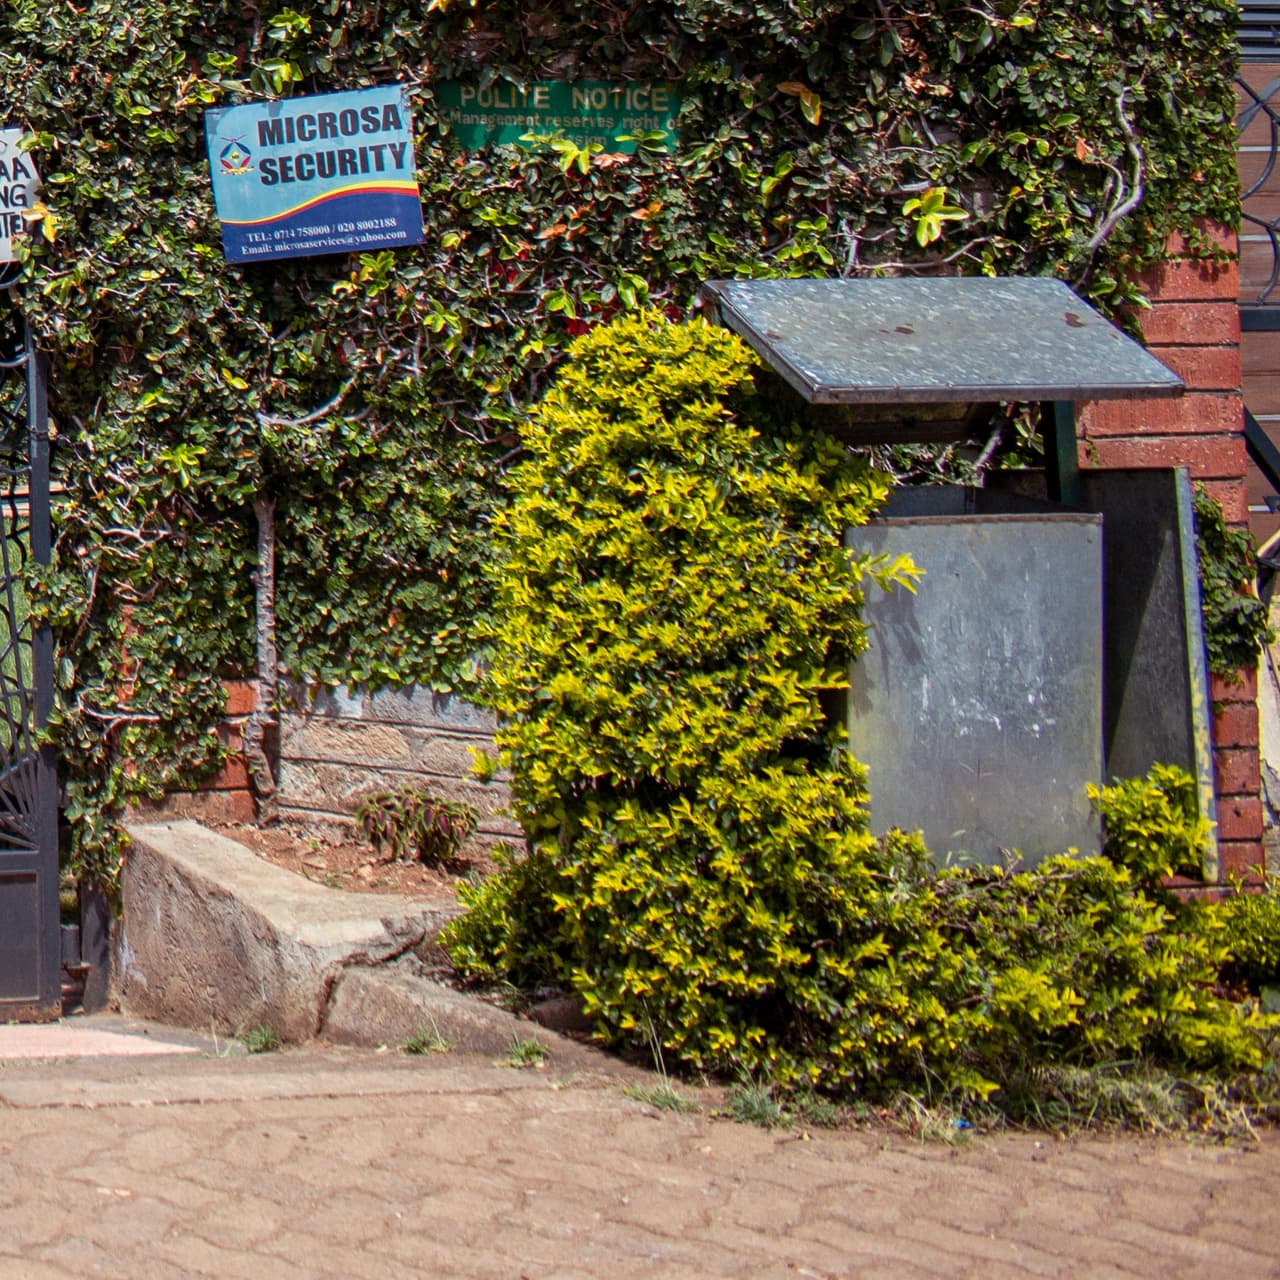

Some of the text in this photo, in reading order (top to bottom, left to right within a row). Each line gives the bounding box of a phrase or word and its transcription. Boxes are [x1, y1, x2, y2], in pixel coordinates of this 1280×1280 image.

[461, 86, 669, 112] POLITE NOTICE
[258, 104, 403, 147] MICROSA
[451, 109, 541, 132] Management
[622, 112, 659, 131] right
[259, 141, 408, 185] SECURITY
[247, 232, 273, 243] TEL:
[338, 222, 354, 233] 020
[241, 242, 273, 255] Email:
